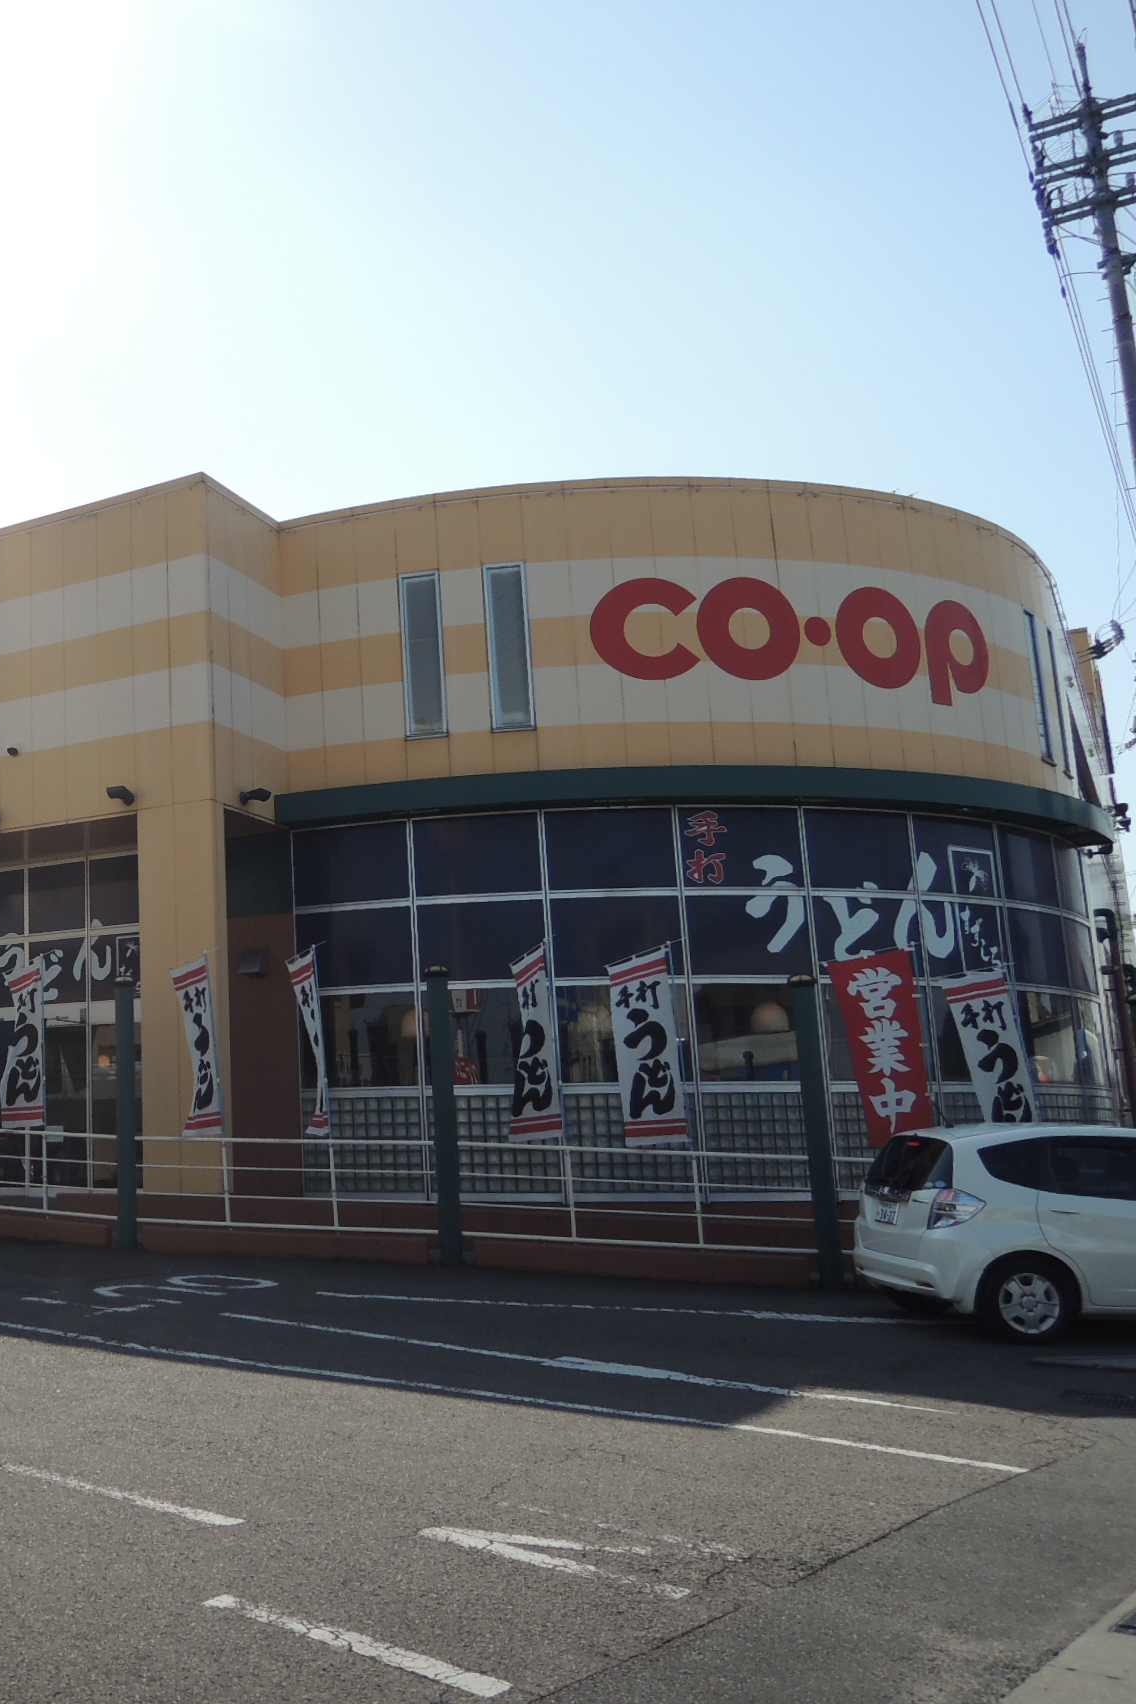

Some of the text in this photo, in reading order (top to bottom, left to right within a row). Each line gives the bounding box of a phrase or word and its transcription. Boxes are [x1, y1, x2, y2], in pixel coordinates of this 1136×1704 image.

[685, 810, 727, 885] 手打
[745, 851, 954, 960] うどん
[615, 981, 661, 1010] 手打
[960, 1000, 1007, 1031] 手打
[6, 1012, 40, 1107] うどん
[623, 1008, 676, 1119] うどん
[846, 966, 917, 1134] 営業中
